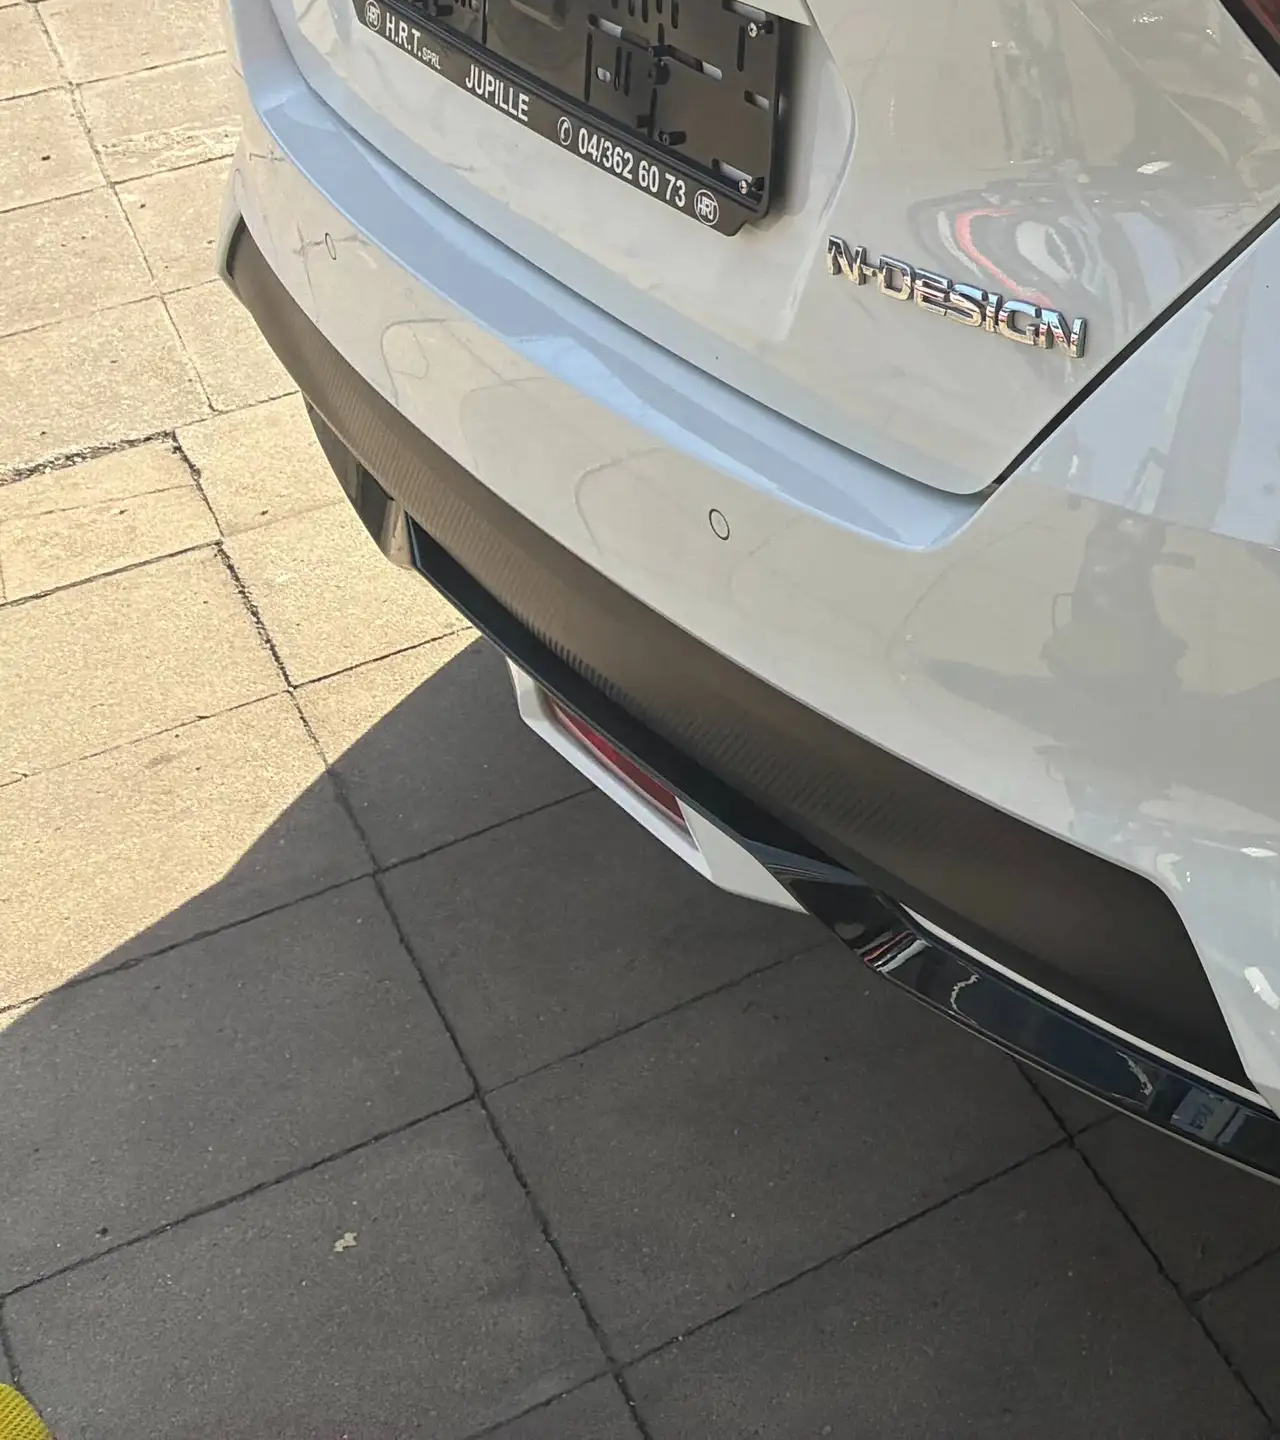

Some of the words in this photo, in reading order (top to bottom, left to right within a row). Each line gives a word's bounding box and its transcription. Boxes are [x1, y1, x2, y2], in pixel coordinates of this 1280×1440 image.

[386, 12, 421, 56] H.R.T.
[422, 46, 441, 69] SPRL
[465, 64, 529, 121] JUPILLE
[578, 127, 634, 180] 04/362
[638, 160, 660, 193] 60
[665, 172, 686, 207] 73
[827, 235, 1087, 358] N-DESIGN
